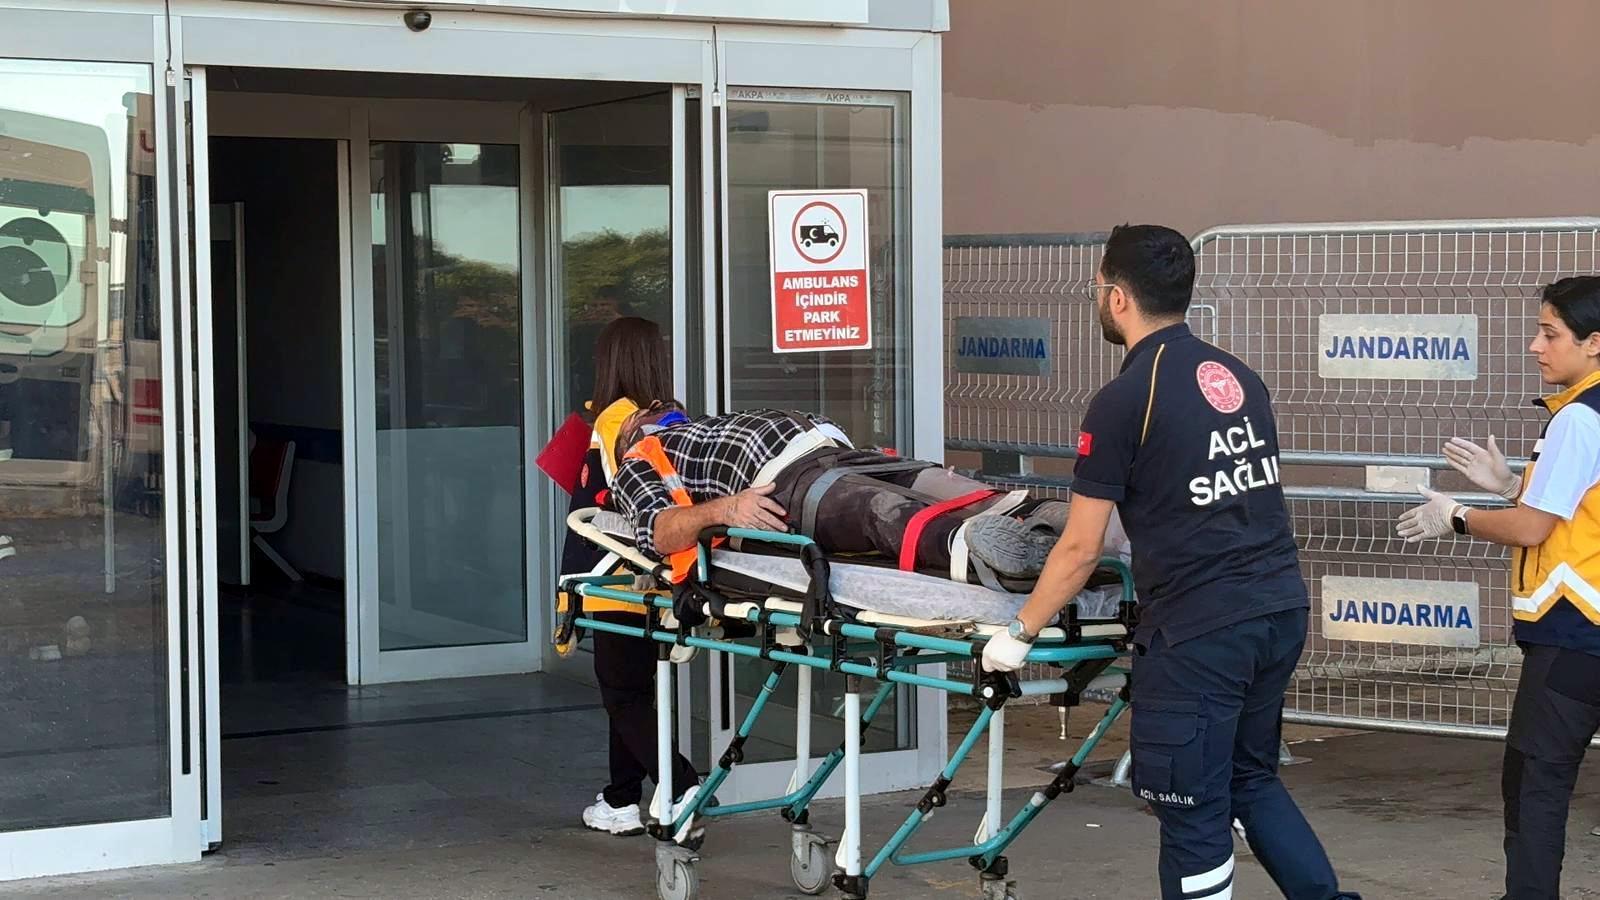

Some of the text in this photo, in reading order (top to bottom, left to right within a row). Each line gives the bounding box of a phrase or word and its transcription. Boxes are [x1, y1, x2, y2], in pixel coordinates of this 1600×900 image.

[738, 90, 764, 99] AKPA
[826, 93, 851, 103] AKPA
[782, 275, 859, 290] AMBULANS
[795, 291, 848, 309] İÇİNDİR
[803, 310, 841, 323] PARK
[784, 325, 860, 342] ETMEYİNİZ
[958, 336, 1046, 359] JANDARMA
[1325, 335, 1470, 361] JANDARMA
[1208, 416, 1266, 460] ACİL
[1329, 599, 1473, 629] JANDARMA
[1159, 792, 1195, 805] SAĞLIK
